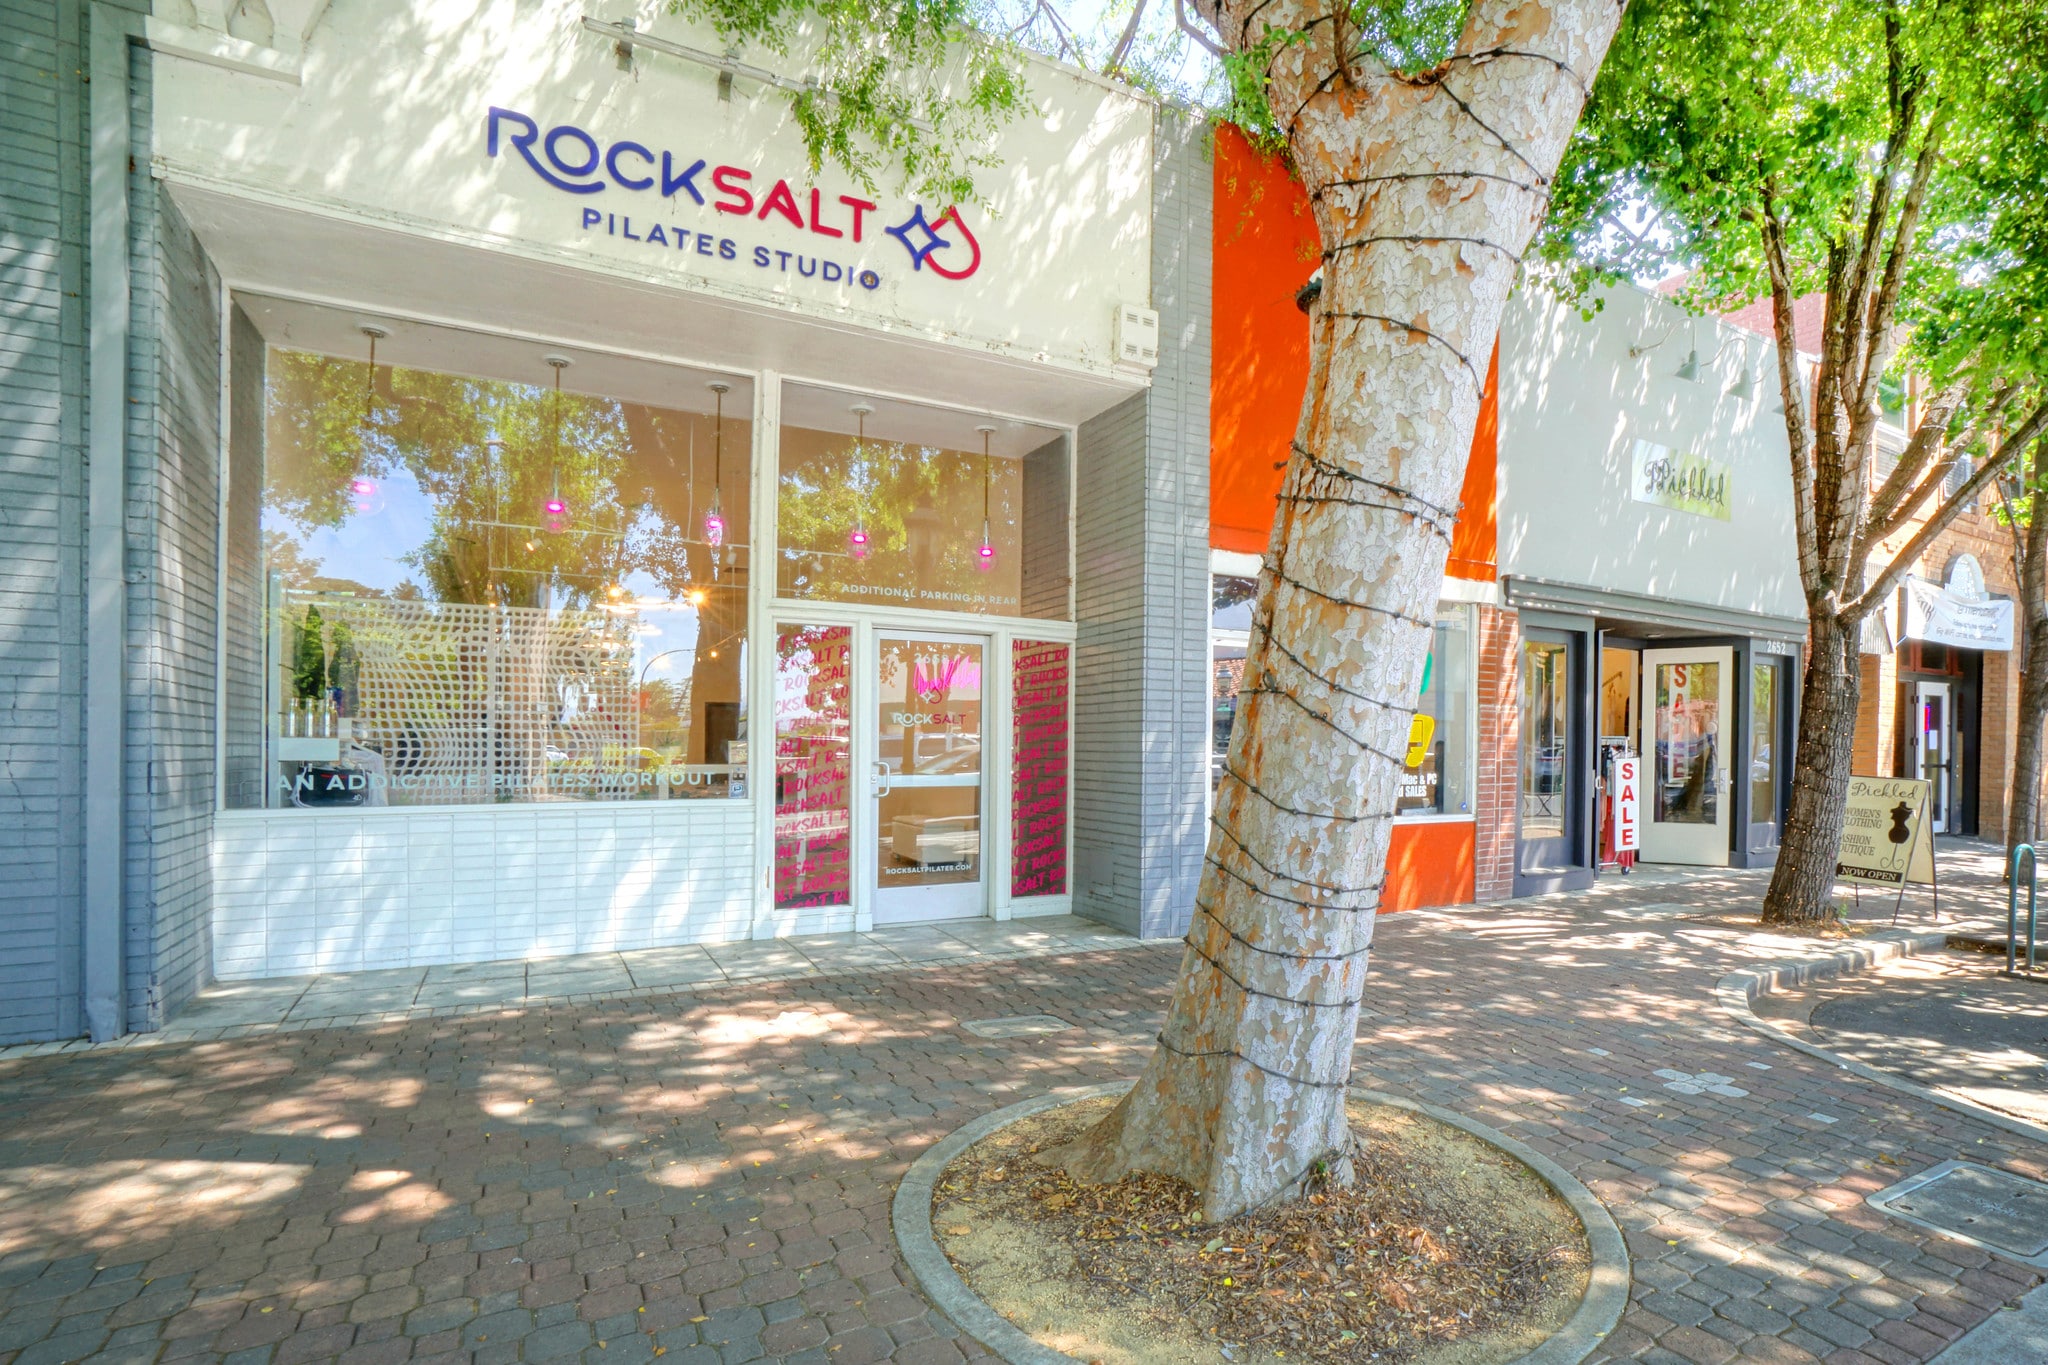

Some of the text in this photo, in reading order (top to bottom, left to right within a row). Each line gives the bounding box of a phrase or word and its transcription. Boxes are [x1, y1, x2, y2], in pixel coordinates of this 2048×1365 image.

[488, 105, 878, 243] ROCKSALT
[582, 207, 881, 291] PILATES STUDIO
[1644, 457, 1725, 508] Pickled
[841, 584, 1017, 606] ADDITIONAL PARKING IN REAR
[1766, 640, 1786, 655] 2652
[892, 712, 967, 728] ROCKSALT
[277, 774, 314, 791] AN
[326, 773, 479, 791] ADDICTIVE
[491, 772, 591, 787] PILATES
[600, 771, 716, 786] WORKOUT
[1419, 774, 1426, 785] &
[1405, 785, 1427, 798] SALES
[1851, 782, 1919, 800] Pickled
[1621, 762, 1635, 847] SALE
[1842, 833, 1872, 846] ASHION
[1839, 843, 1876, 857] OUTIQUE
[885, 864, 972, 875] ROCKSALTPILATES.COM
[1841, 866, 1897, 881] NOW OPEN
